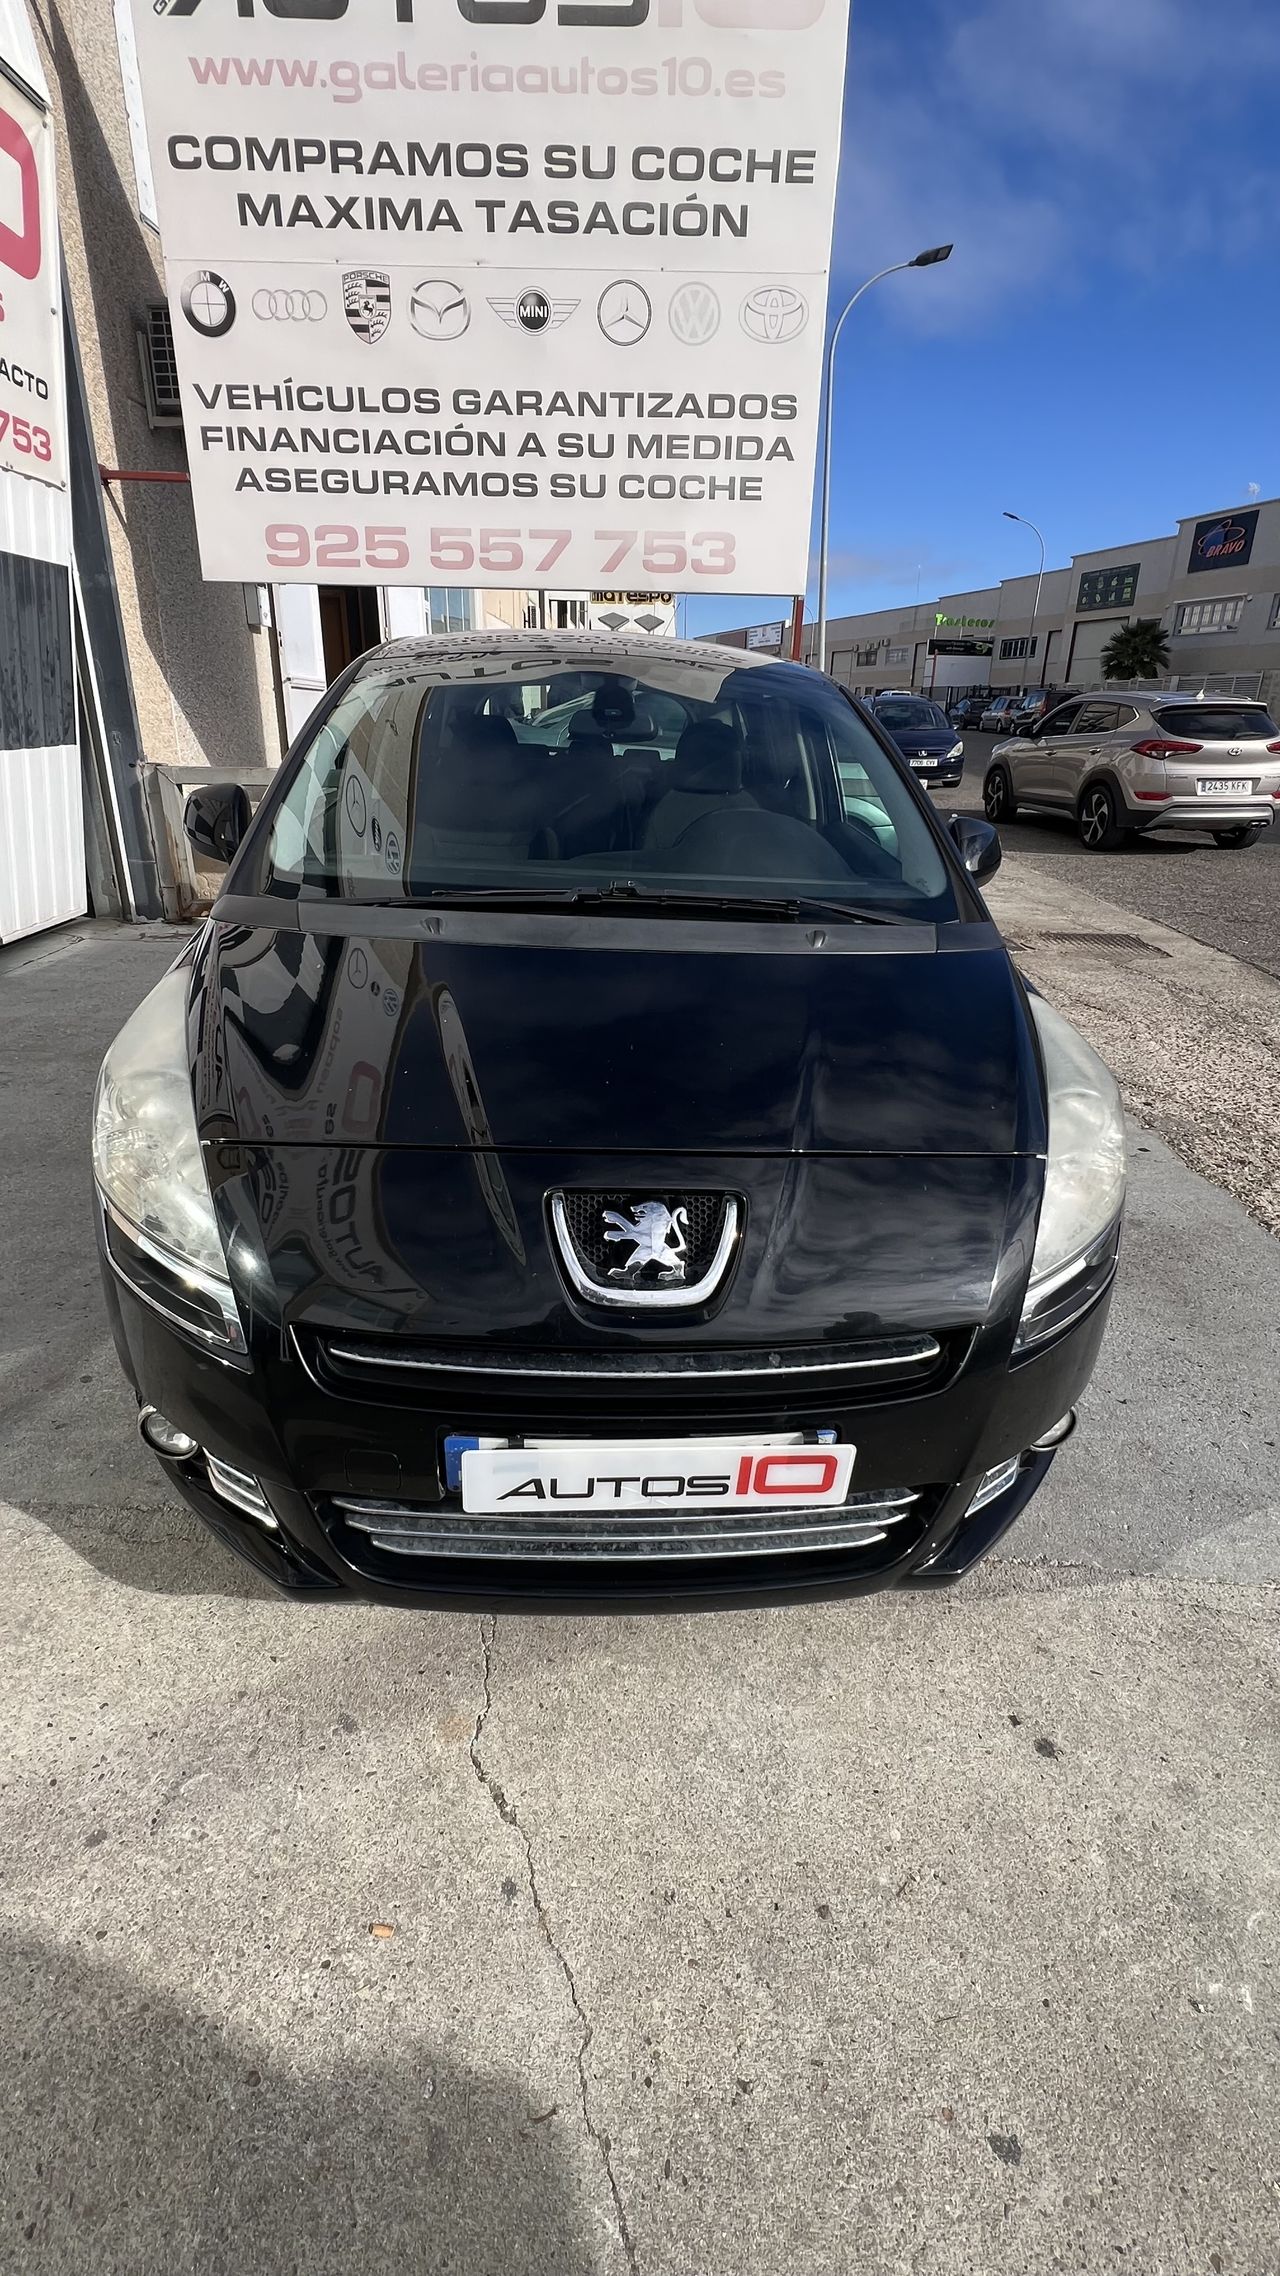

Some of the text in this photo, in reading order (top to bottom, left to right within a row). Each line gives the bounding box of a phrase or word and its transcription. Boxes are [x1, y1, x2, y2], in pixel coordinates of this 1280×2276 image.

[187, 50, 786, 104] www.galeriaautos10.es
[168, 135, 817, 184] COMPRAMOS SU COCHE
[237, 193, 748, 237] MAXIMA TASACIÓN
[343, 271, 390, 282] PORSCHE
[519, 304, 548, 318] MINI
[193, 377, 798, 420] VEHÍCULOS GARANTIZADOS
[201, 423, 795, 461] FINANCIACIÓN A SU MEDIDA
[235, 468, 763, 500] ASEGURAMOS SU COCHE
[265, 524, 737, 576] 925 557 753
[1206, 540, 1245, 557] BRAVO
[1207, 782, 1247, 791] 2435 KFK
[495, 1455, 839, 1501] AUTOS10
